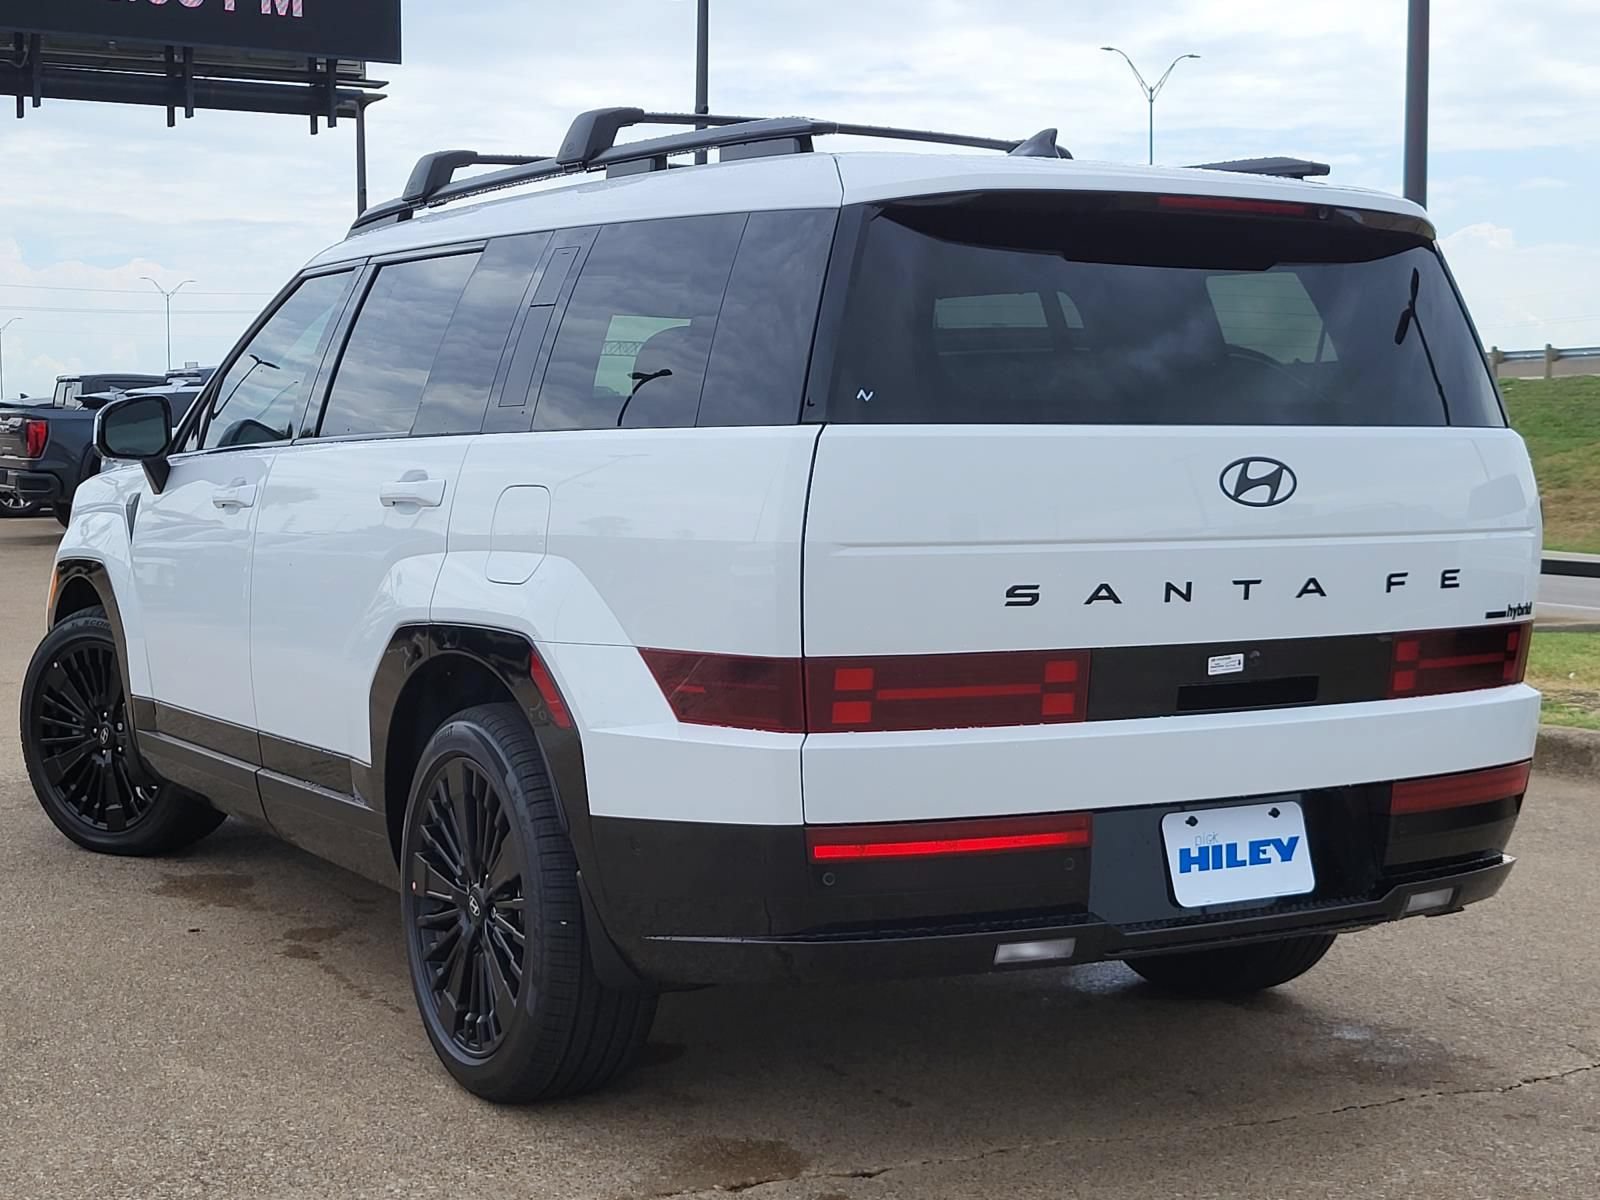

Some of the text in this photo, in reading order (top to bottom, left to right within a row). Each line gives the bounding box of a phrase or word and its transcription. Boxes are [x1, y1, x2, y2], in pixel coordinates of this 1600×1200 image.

[1004, 568, 1461, 607] SANTA FE
[1506, 601, 1532, 620] hybrid
[1179, 836, 1299, 873] HILEY
